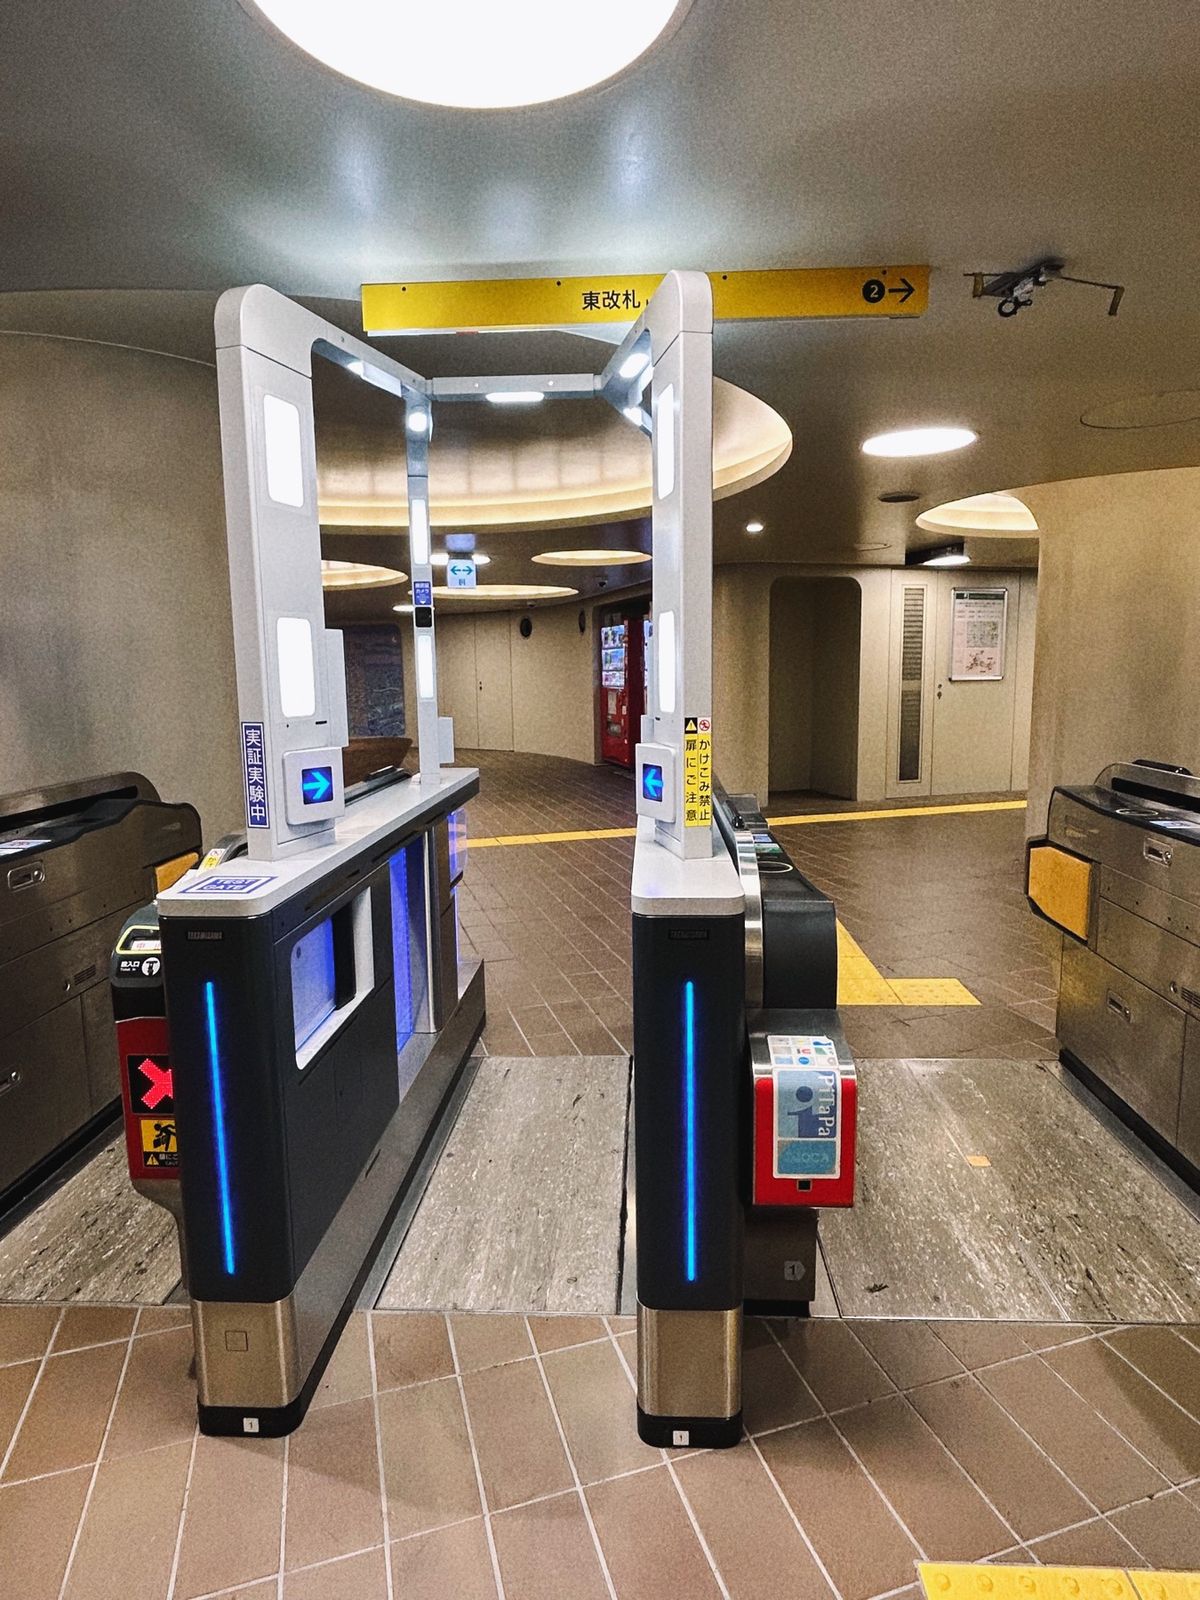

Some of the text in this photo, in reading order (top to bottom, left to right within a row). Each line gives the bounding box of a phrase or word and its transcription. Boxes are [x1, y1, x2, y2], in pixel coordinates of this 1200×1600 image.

[581, 289, 649, 311] 東改札
[245, 728, 265, 821] 実証実験中
[685, 739, 697, 822] 扉にご注意
[699, 739, 711, 821] かけこみ禁止
[817, 1075, 835, 1137] PiTaPa
[789, 1264, 796, 1275] 1
